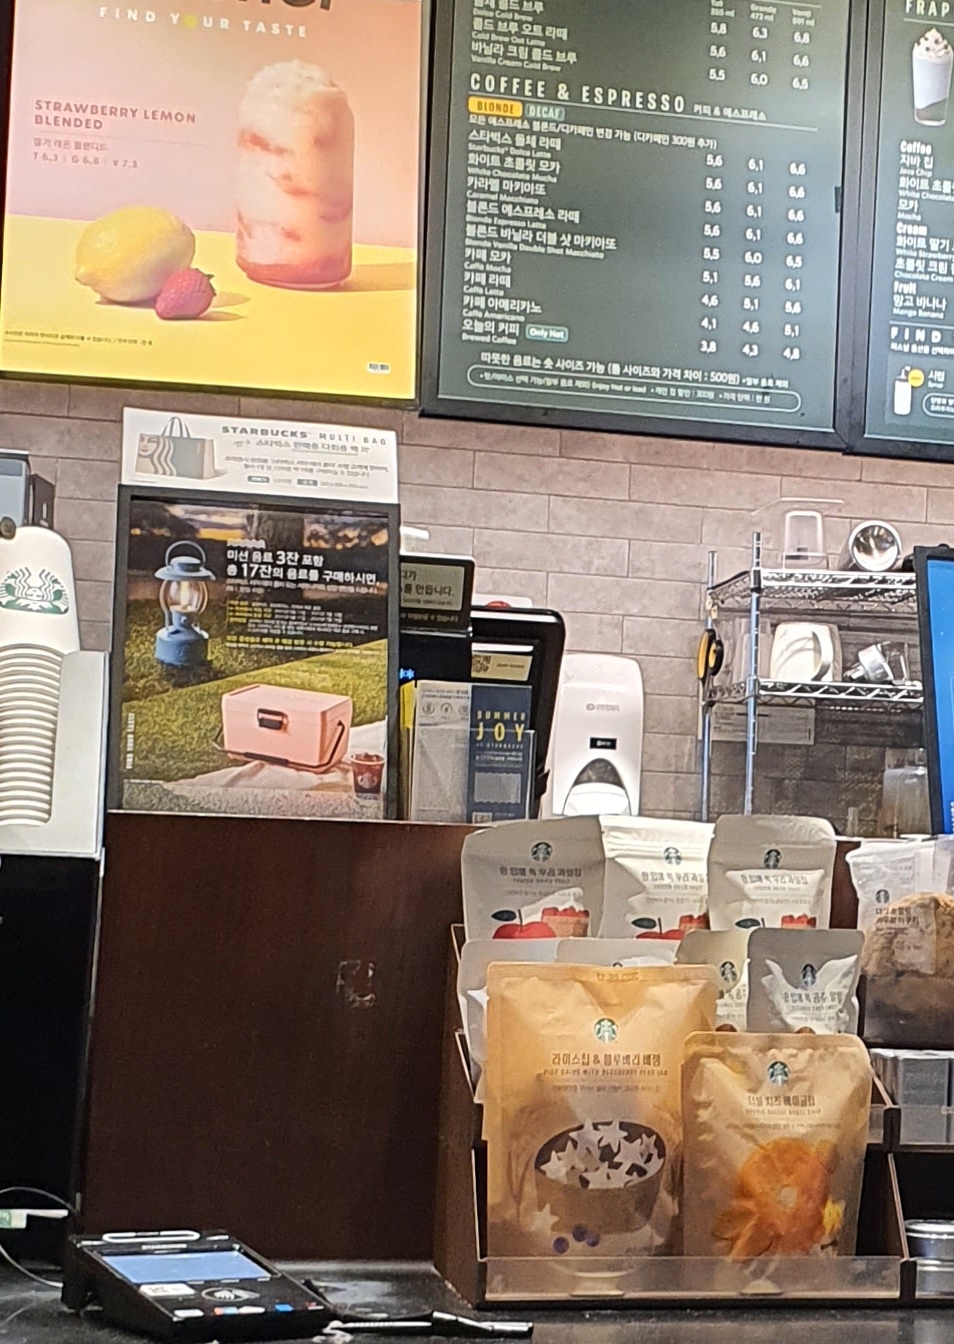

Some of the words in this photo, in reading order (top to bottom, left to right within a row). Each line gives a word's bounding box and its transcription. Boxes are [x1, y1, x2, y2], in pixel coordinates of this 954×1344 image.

[99, 6, 155, 22] FIND
[243, 20, 305, 37] TASTE
[470, 73, 544, 97] COFFEE
[557, 83, 569, 100] &
[582, 85, 684, 112] ESPRESSO
[35, 99, 137, 117] STRAWBERRY
[143, 109, 195, 123] LEMON
[477, 100, 513, 114] BLONDE
[529, 104, 562, 120] DECAF
[34, 114, 102, 129] BLENDED
[468, 129, 512, 144] 스타벅스
[515, 133, 536, 148] 돌체
[538, 136, 561, 150] 라떼
[900, 140, 931, 155] Coffee
[467, 152, 500, 166] 화이트
[503, 156, 535, 171] 초콜릿
[538, 159, 560, 174] 모카
[467, 176, 499, 191] 카라멜
[502, 179, 545, 195] 마키아또
[898, 176, 929, 190] 화이트
[466, 199, 499, 214] 블론드
[501, 203, 555, 219] 에스프레소
[557, 209, 579, 223] 라떼
[897, 198, 918, 212] 모카
[465, 223, 498, 238] 블론드
[500, 227, 533, 242] 바닐라
[536, 231, 557, 245] 더블
[559, 233, 571, 246] 샷
[573, 234, 616, 249] 마키아또
[896, 221, 927, 235] Cream
[895, 235, 926, 248] 화이트
[929, 237, 949, 252] 딸기
[464, 247, 486, 261] 카페
[489, 249, 511, 264] 모카
[894, 257, 925, 272] 초콜릿
[927, 260, 947, 274] 크림
[463, 271, 486, 285] 카페
[488, 273, 510, 288] 라떼
[893, 280, 916, 294] Fruit
[463, 295, 485, 308] 카페
[487, 297, 541, 313] 아메리카노
[893, 293, 913, 307] 망고
[915, 296, 946, 310] 바나나
[461, 318, 494, 333] 오늘의
[498, 322, 519, 336] 커피
[890, 326, 941, 342] FIND
[480, 351, 510, 365] 따뜻한
[513, 354, 541, 368] 음료는
[555, 358, 584, 370] 사이즈
[585, 361, 605, 373] 가능
[622, 364, 660, 378] 사이즈와
[662, 367, 681, 379] 가격
[683, 369, 702, 381] 차이
[709, 371, 740, 384] 500원)
[319, 433, 356, 442] MULTI
[363, 437, 387, 446] BAG
[227, 549, 249, 562] 미션
[252, 551, 274, 563] 음료
[276, 551, 300, 566] 3잔
[301, 554, 324, 567] 포함
[227, 564, 238, 576] 총
[241, 564, 284, 579] 17잔의
[286, 568, 319, 581] 음료를
[322, 570, 380, 586] 구매하시면,
[476, 710, 527, 722] SUMMER
[476, 722, 525, 742] JOY
[552, 1053, 590, 1066] 라이스칩
[592, 1054, 600, 1064] &
